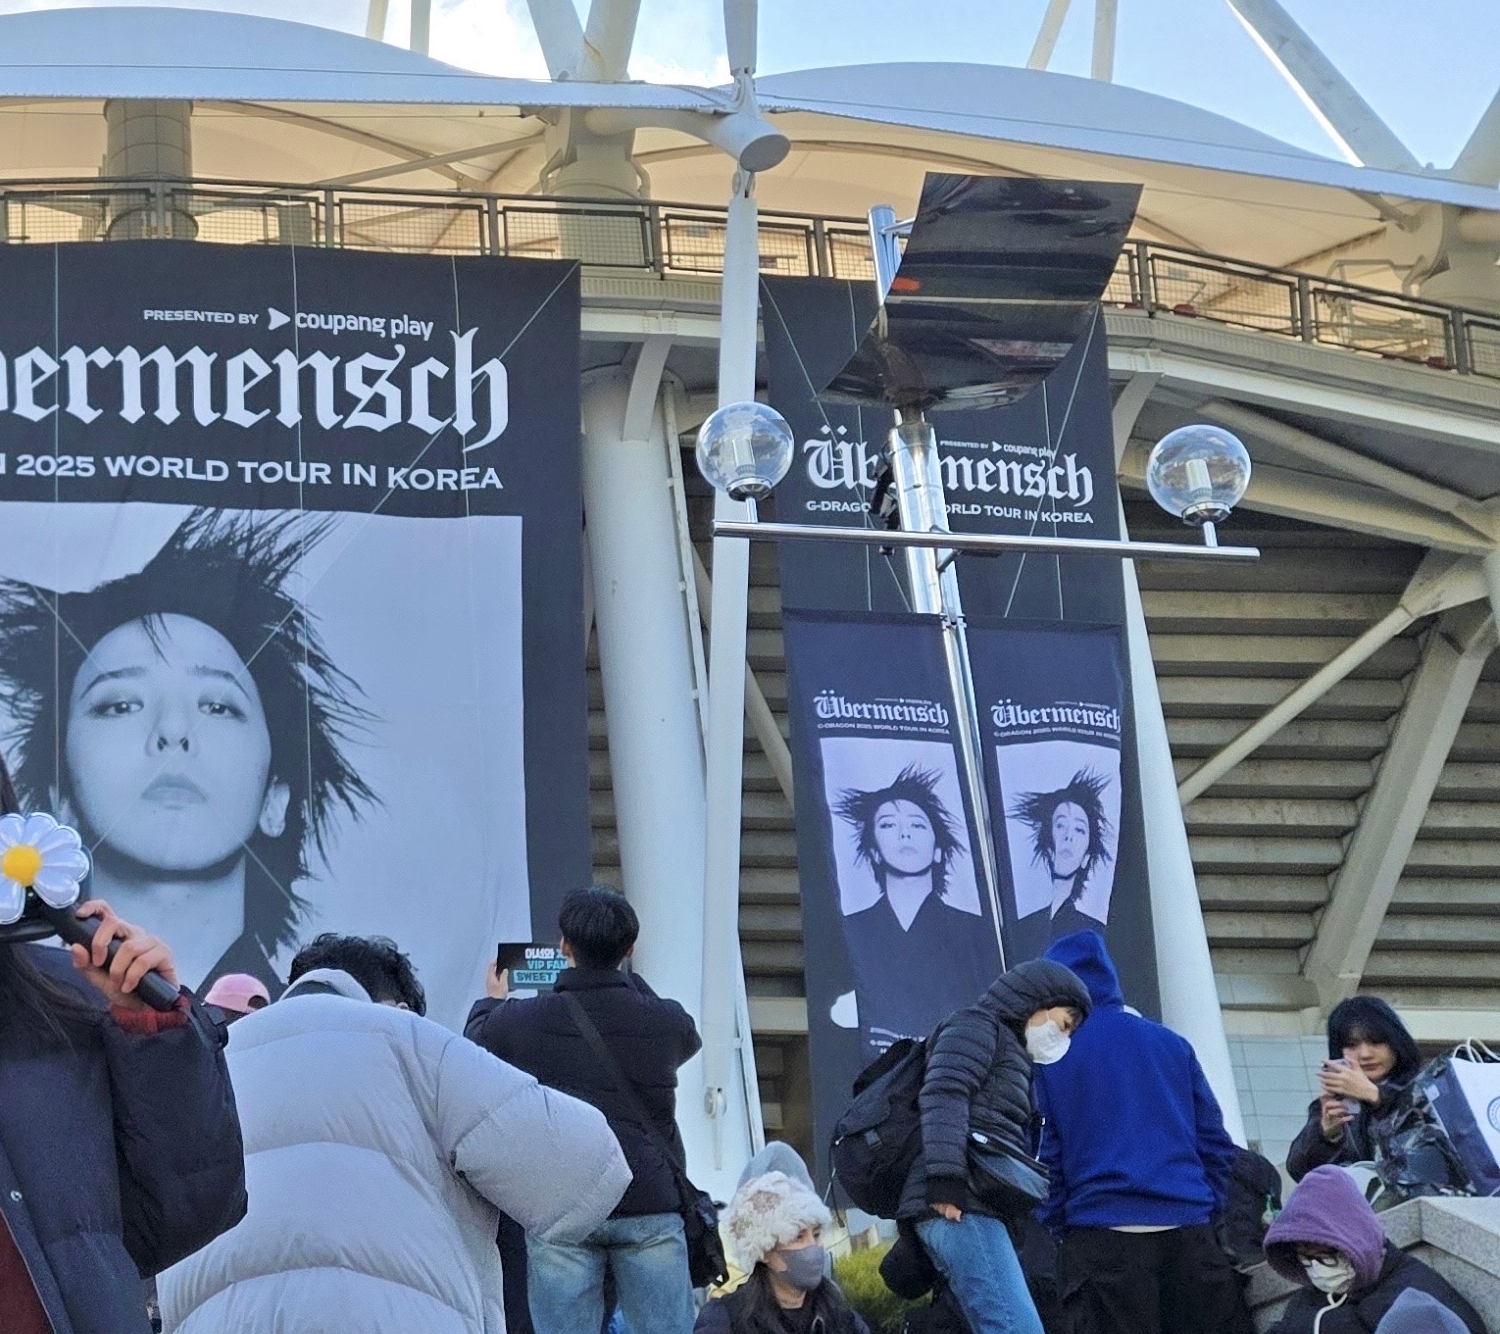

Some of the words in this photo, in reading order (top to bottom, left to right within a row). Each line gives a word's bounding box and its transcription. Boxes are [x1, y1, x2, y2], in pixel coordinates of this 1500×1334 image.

[143, 309, 235, 324] PRESENTED
[238, 313, 259, 324] BY
[295, 312, 385, 338] coupang
[390, 314, 433, 341] play
[16, 454, 96, 477] 2025
[104, 455, 229, 482] WORLD
[237, 460, 331, 485] TOUR
[343, 463, 377, 487] IN
[388, 466, 504, 491] KOREA
[803, 424, 1094, 507] Übmensch
[806, 500, 871, 512] G-DRAGO
[984, 505, 1022, 519] TOUR
[1025, 510, 1038, 521] IN
[1041, 512, 1094, 524] KOREA
[813, 689, 949, 727] Übermensch
[516, 972, 553, 982] SWEET
[527, 960, 545, 969] VIP
